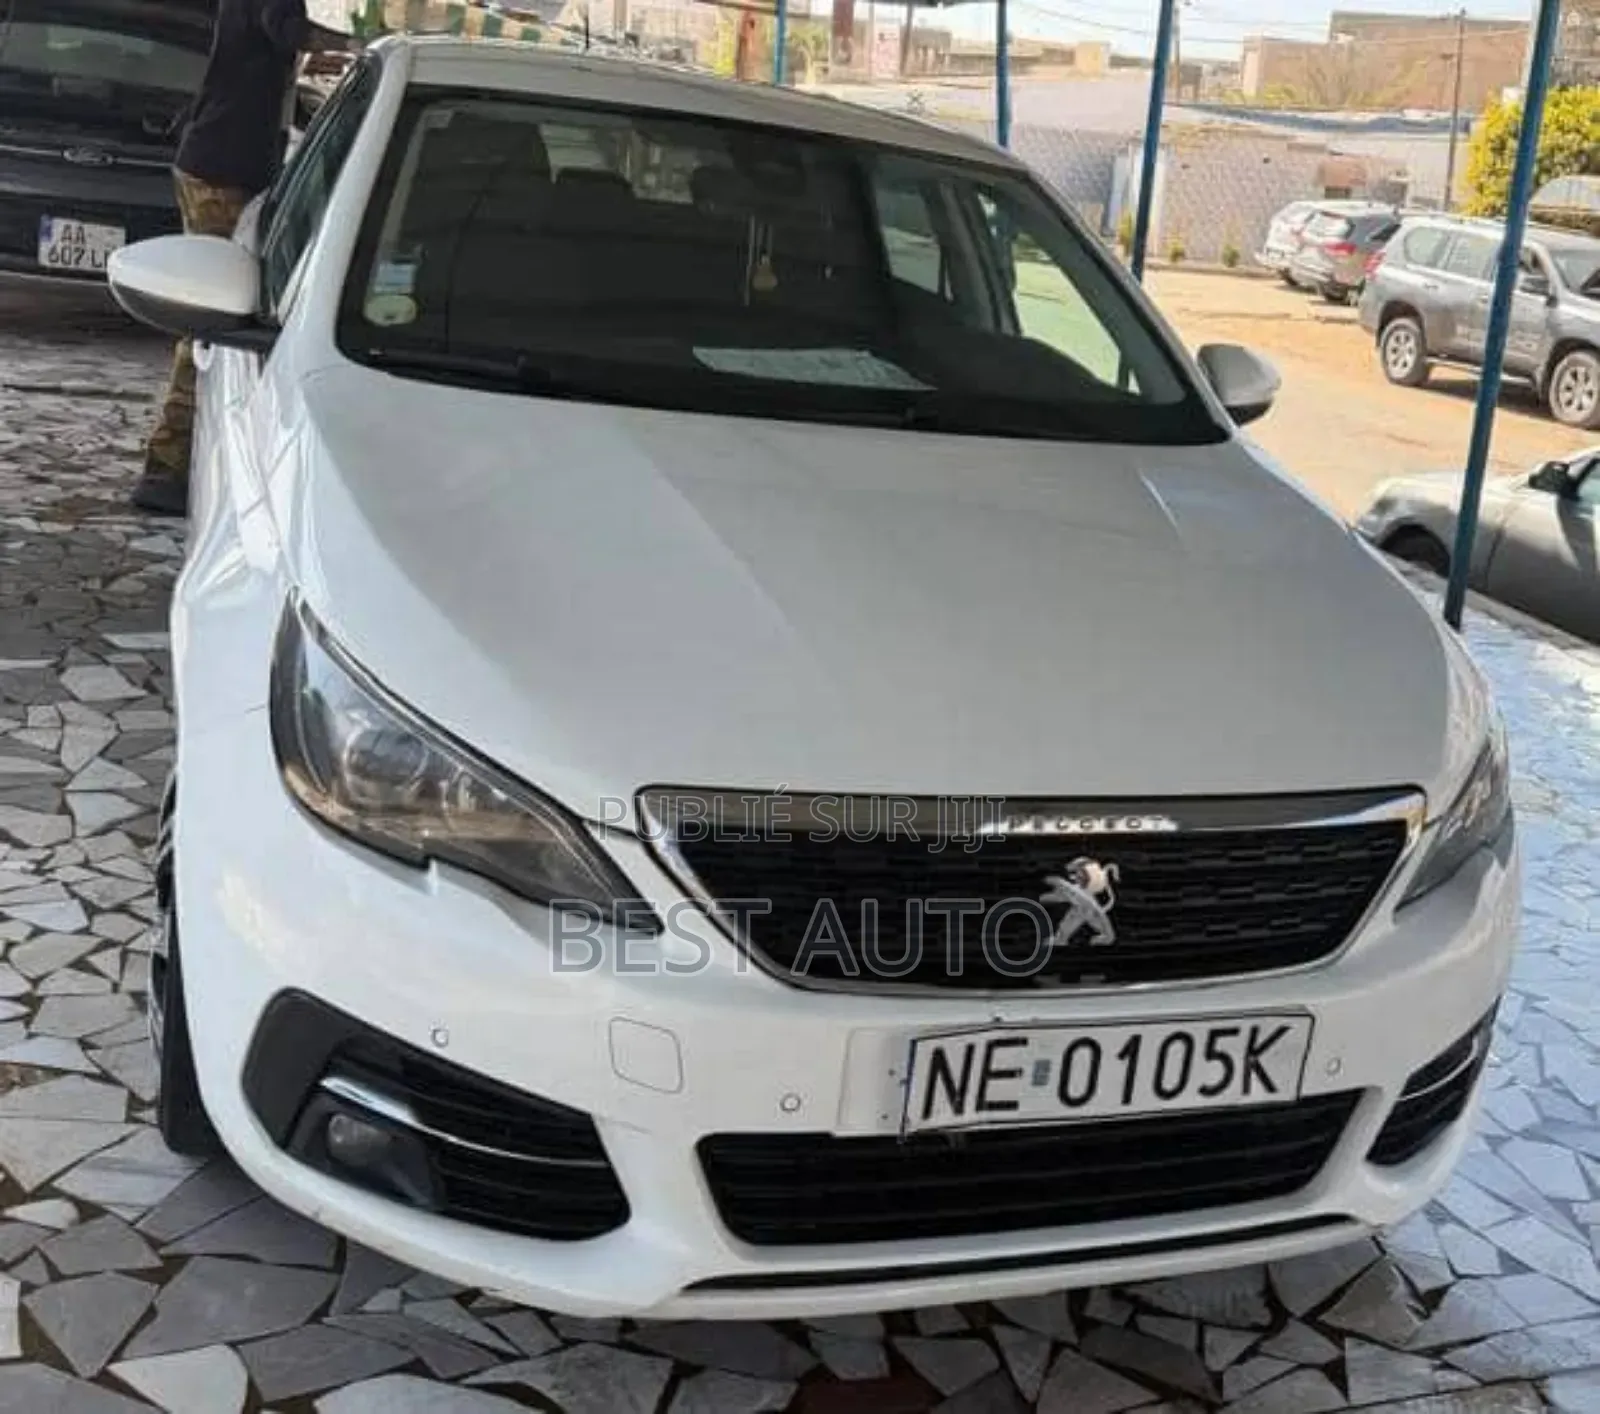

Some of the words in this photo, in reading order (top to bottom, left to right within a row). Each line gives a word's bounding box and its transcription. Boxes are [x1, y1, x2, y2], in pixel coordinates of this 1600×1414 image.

[61, 223, 86, 244] AA
[1005, 814, 1172, 834] PEUGEOT
[922, 1036, 1029, 1120] NE
[1057, 1024, 1292, 1108] 0105K
